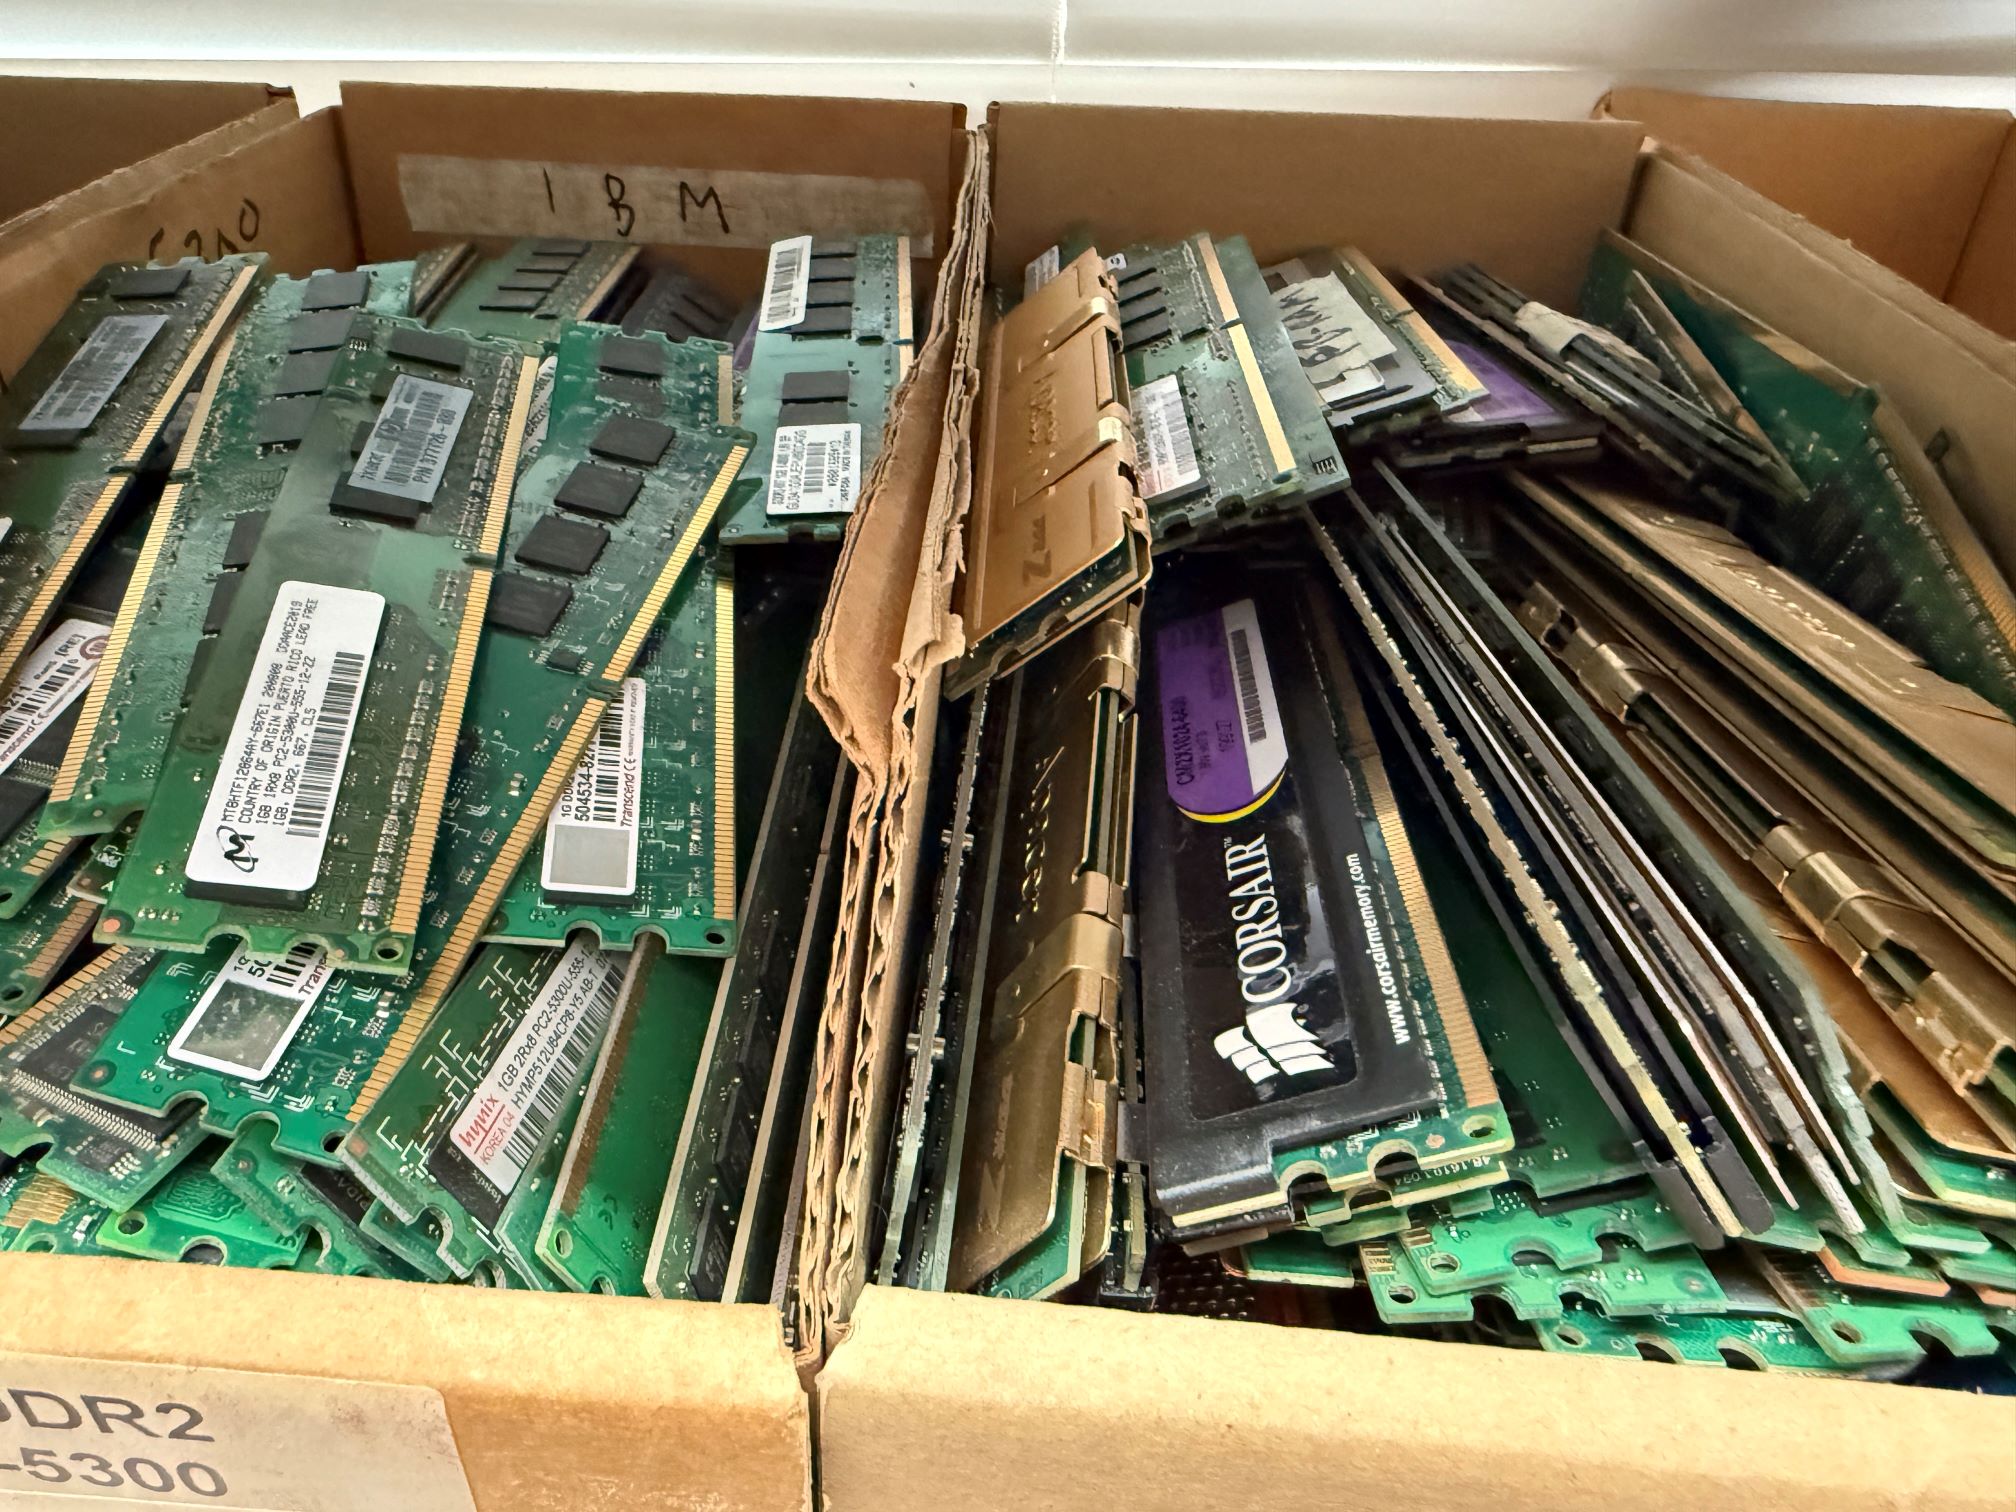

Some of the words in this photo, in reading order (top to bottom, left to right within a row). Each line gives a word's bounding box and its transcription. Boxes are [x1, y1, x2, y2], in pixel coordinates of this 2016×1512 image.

[284, 647, 303, 671] RICO
[272, 675, 294, 710] PUERTO
[259, 714, 282, 752] ORIGIN
[253, 758, 269, 771] OF
[237, 776, 263, 824] COUNTRY
[255, 803, 273, 824] 1GB
[619, 773, 636, 827] Transcend
[1225, 833, 1291, 1003] CORSAIR
[1346, 853, 1411, 1045] www.corsairmemory.com
[498, 1064, 518, 1092] 1GB
[514, 1034, 538, 1068] 2Rx8
[459, 1094, 499, 1147] hynix
[482, 1127, 507, 1165] KOREA
[0, 1388, 215, 1442] DR2
[0, 1446, 229, 1497] -5300
